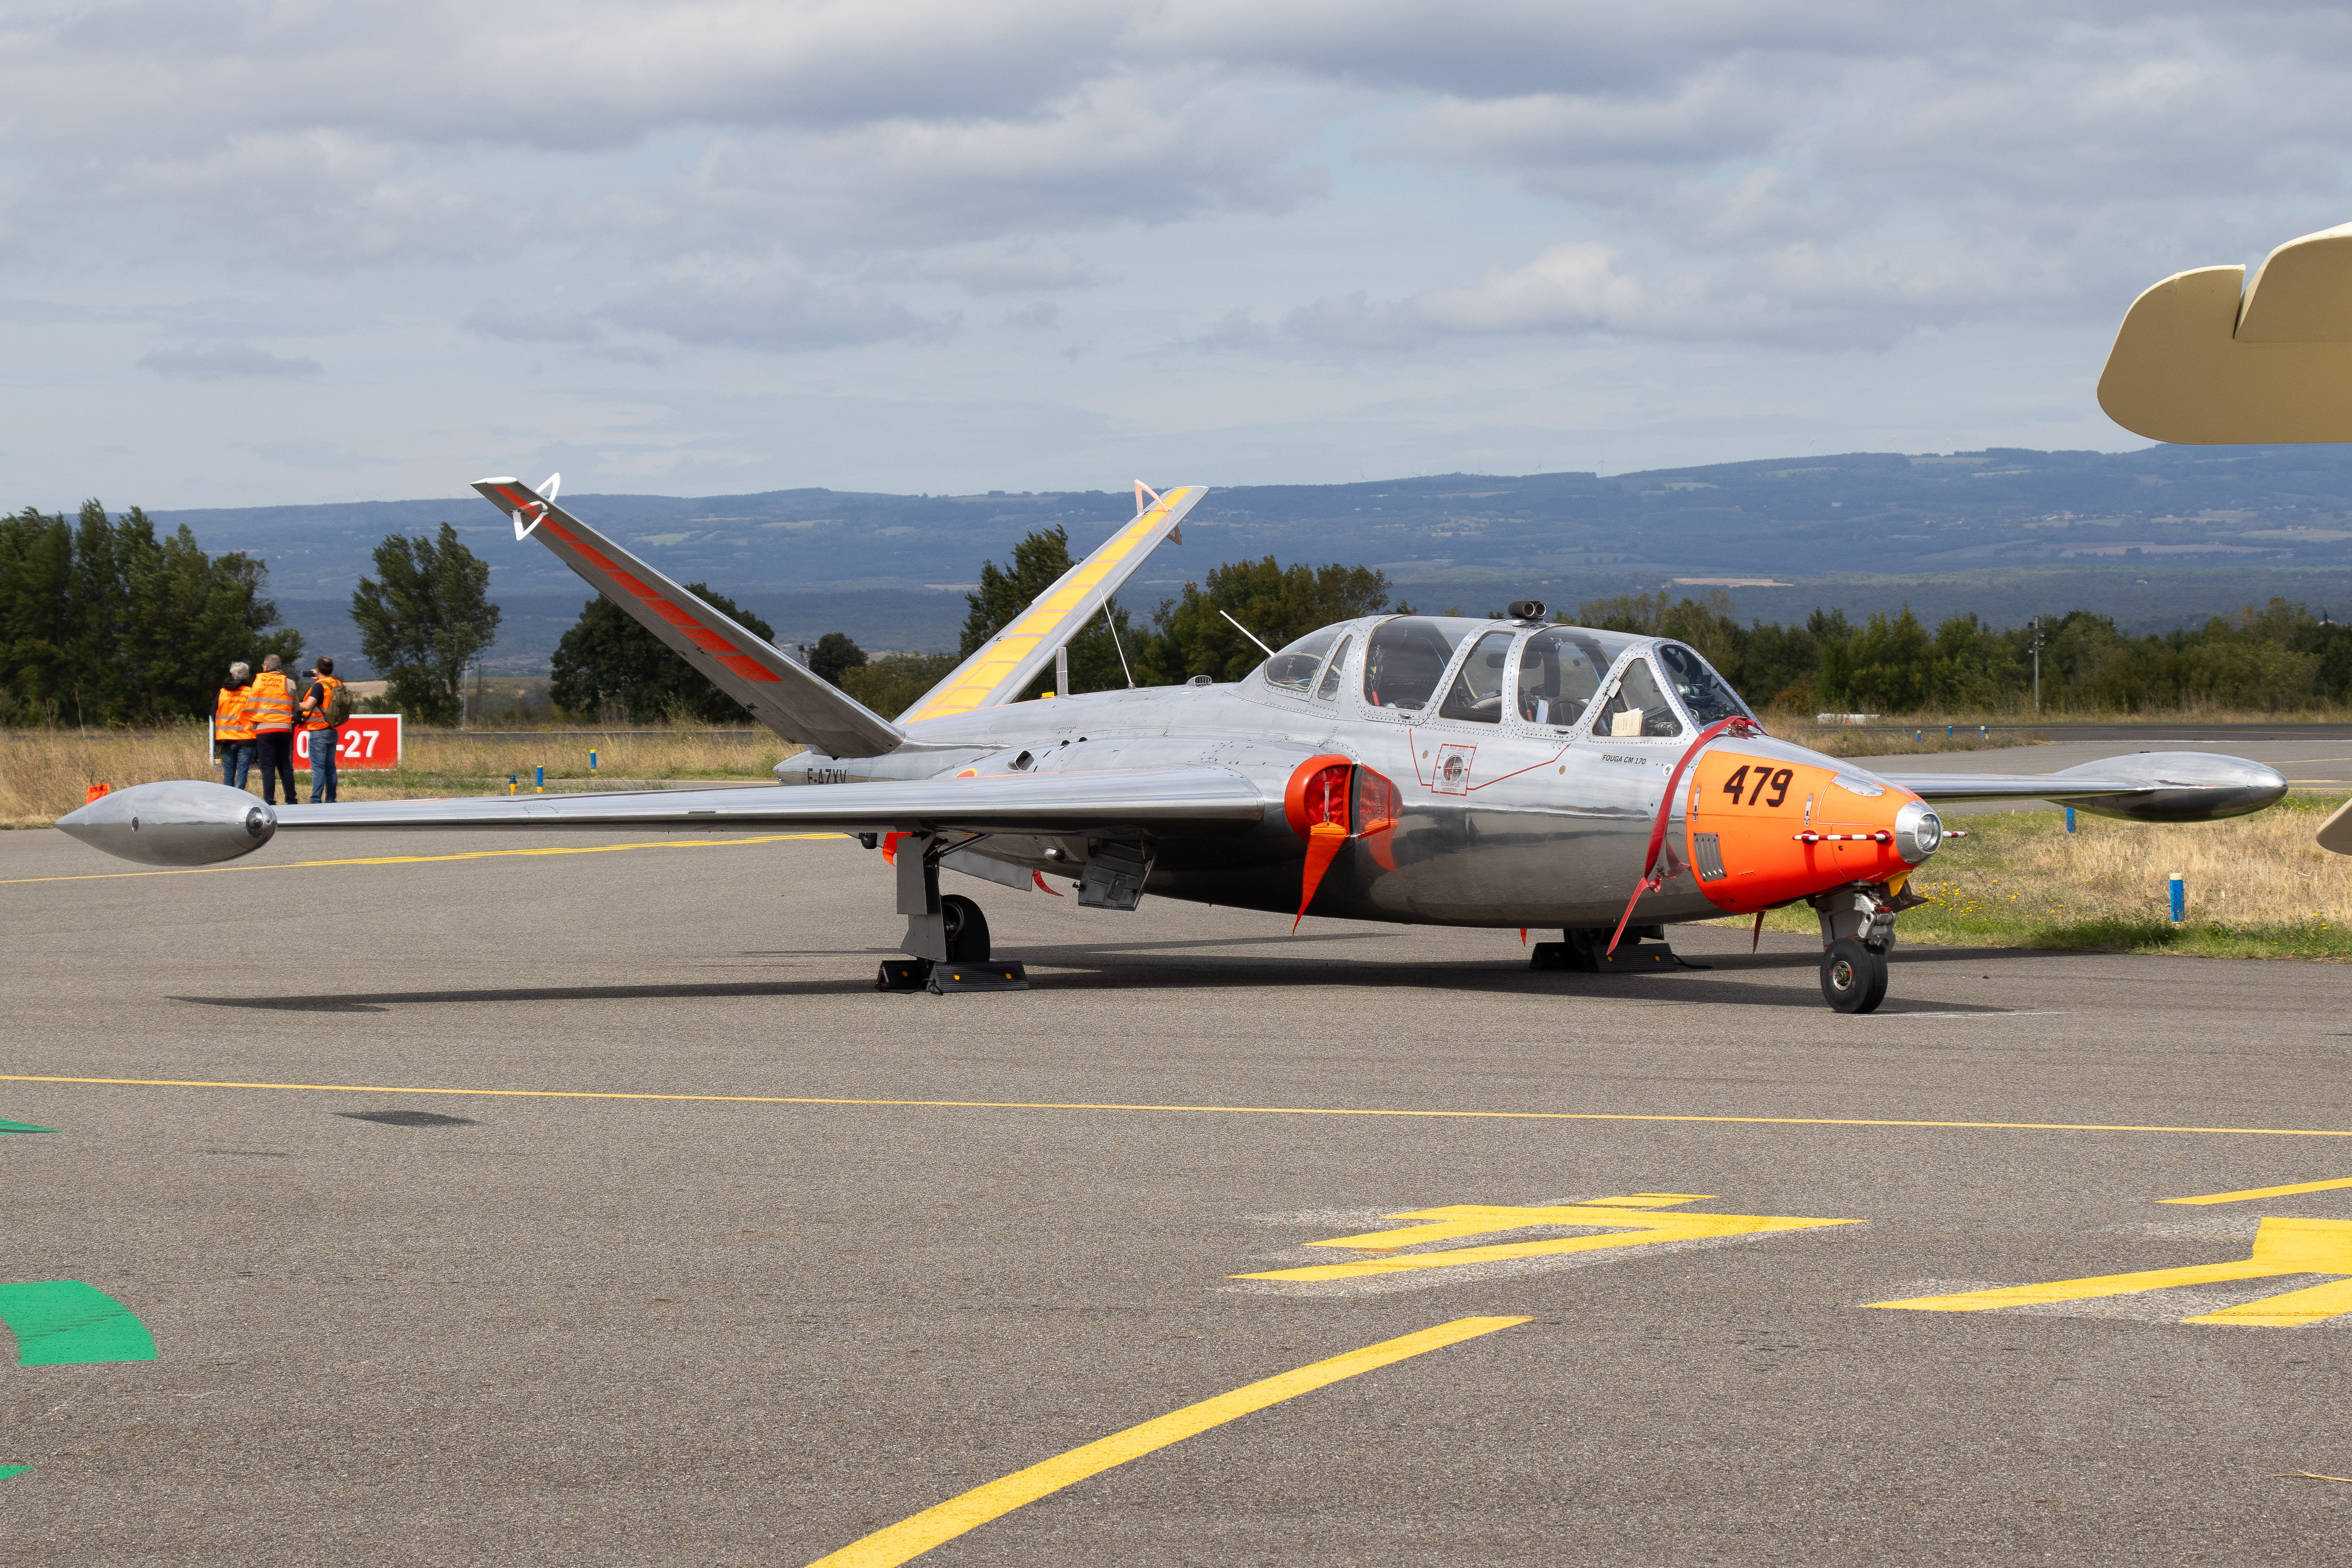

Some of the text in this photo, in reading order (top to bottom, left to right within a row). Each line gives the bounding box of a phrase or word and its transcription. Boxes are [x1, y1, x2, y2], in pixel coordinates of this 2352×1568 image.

[297, 730, 379, 758] 0-27
[1602, 754, 1622, 762] FOUGA
[1723, 765, 1794, 807] 479
[1361, 805, 1385, 815] DANGER
